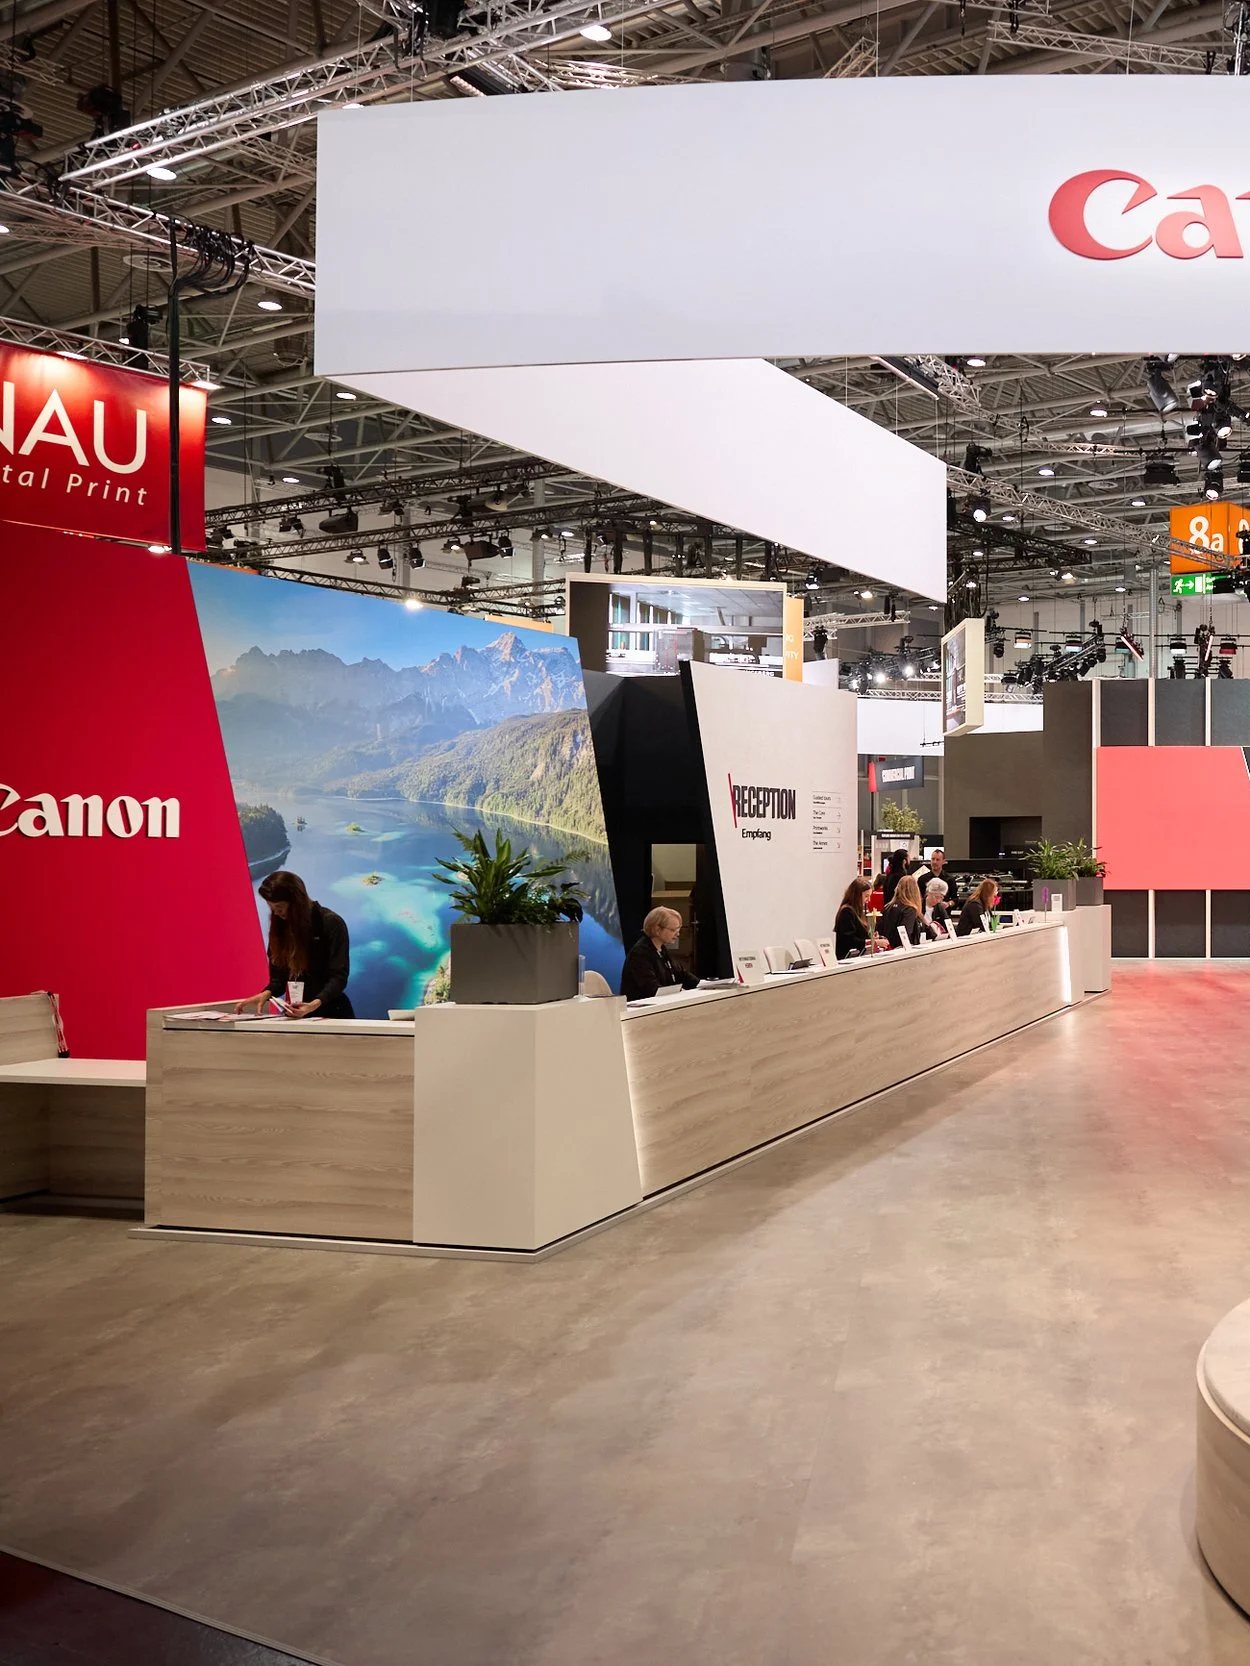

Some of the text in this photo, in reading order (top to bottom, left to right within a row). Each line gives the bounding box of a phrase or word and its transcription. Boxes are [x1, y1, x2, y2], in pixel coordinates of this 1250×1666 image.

[2, 464, 147, 506] tal Print
[1189, 516, 1225, 562] 8a
[732, 784, 796, 820] RECEPTION
[741, 828, 772, 841] Empfang
